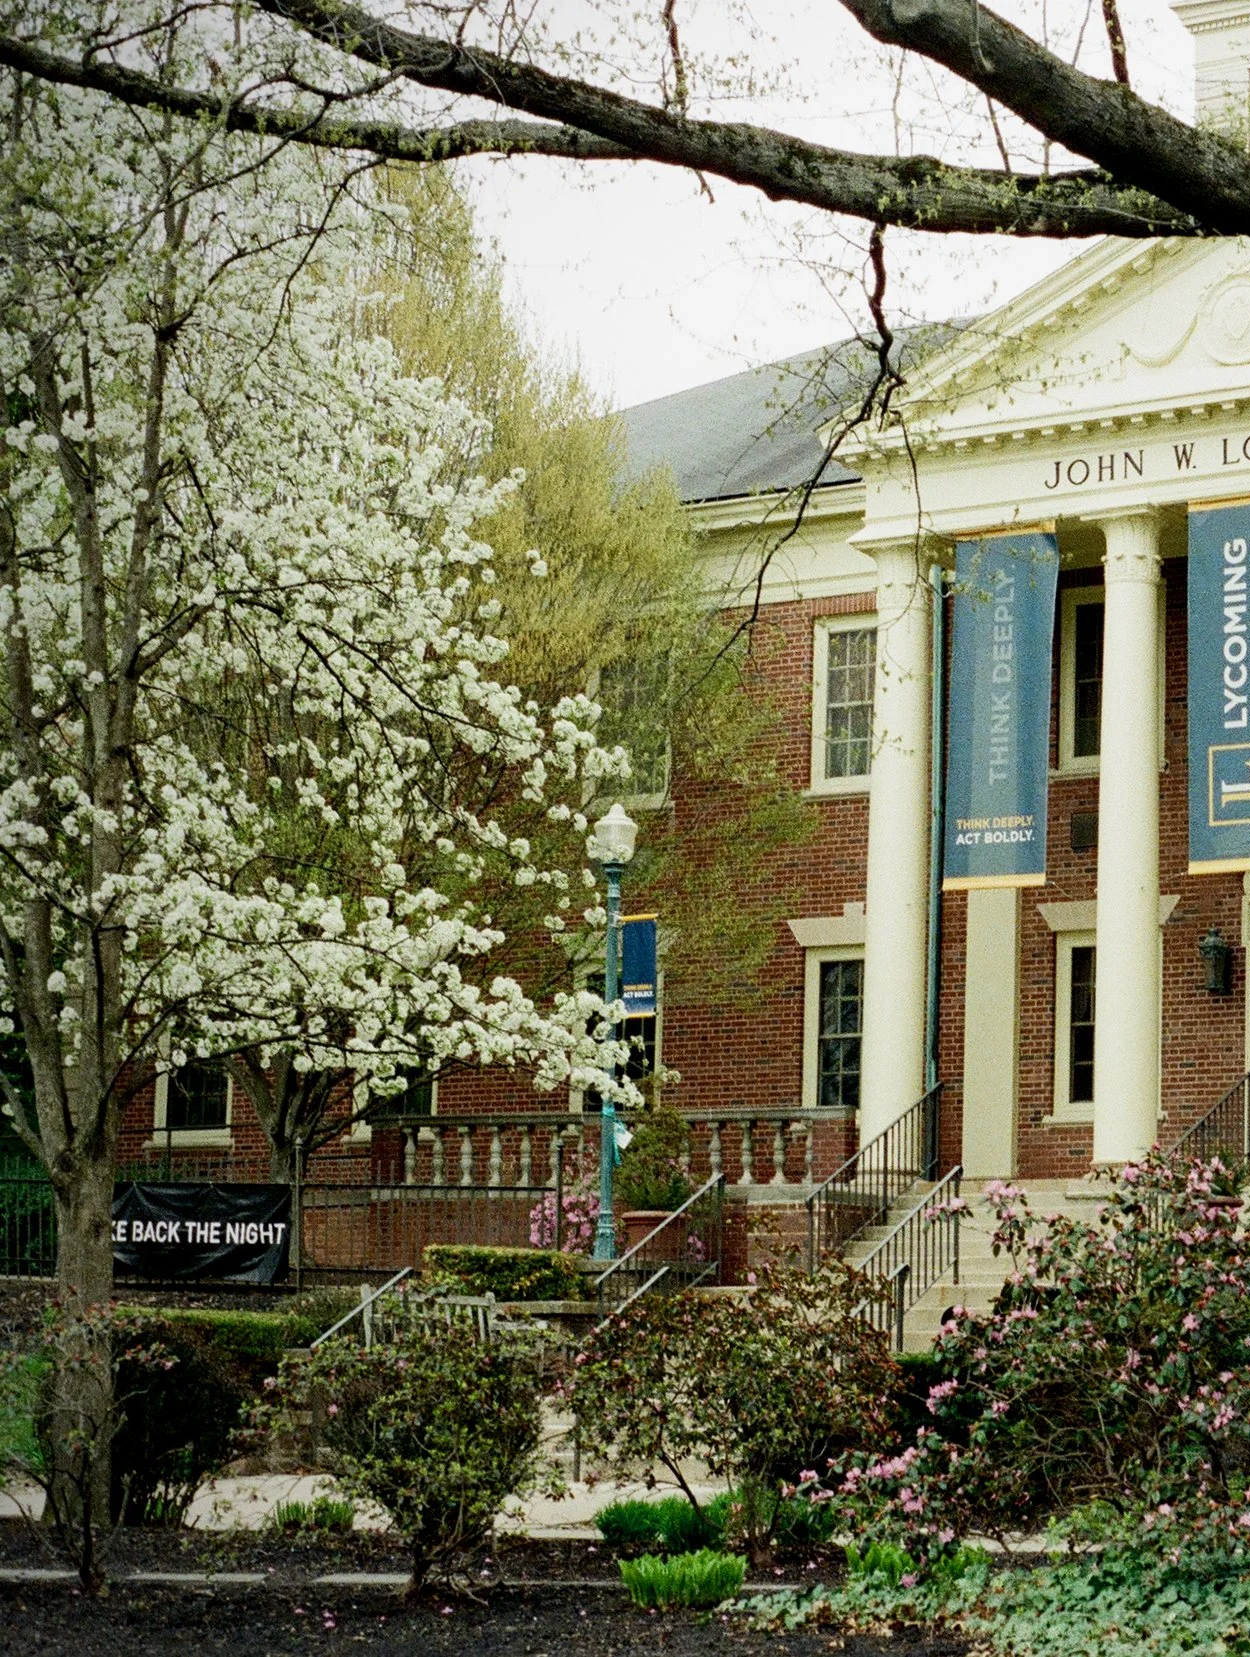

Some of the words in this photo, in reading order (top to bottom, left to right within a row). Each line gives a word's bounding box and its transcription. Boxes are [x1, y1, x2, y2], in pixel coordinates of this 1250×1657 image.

[1044, 449, 1145, 490] JOHN
[1223, 537, 1248, 730] LYCOMING
[989, 691, 1011, 786] THINK
[956, 817, 991, 830] THINK
[956, 832, 981, 845] ACT
[984, 829, 1035, 844] BOLDLY.
[132, 1220, 181, 1243] BACK
[185, 1221, 220, 1244] THE
[226, 1222, 286, 1245] NIGHT
